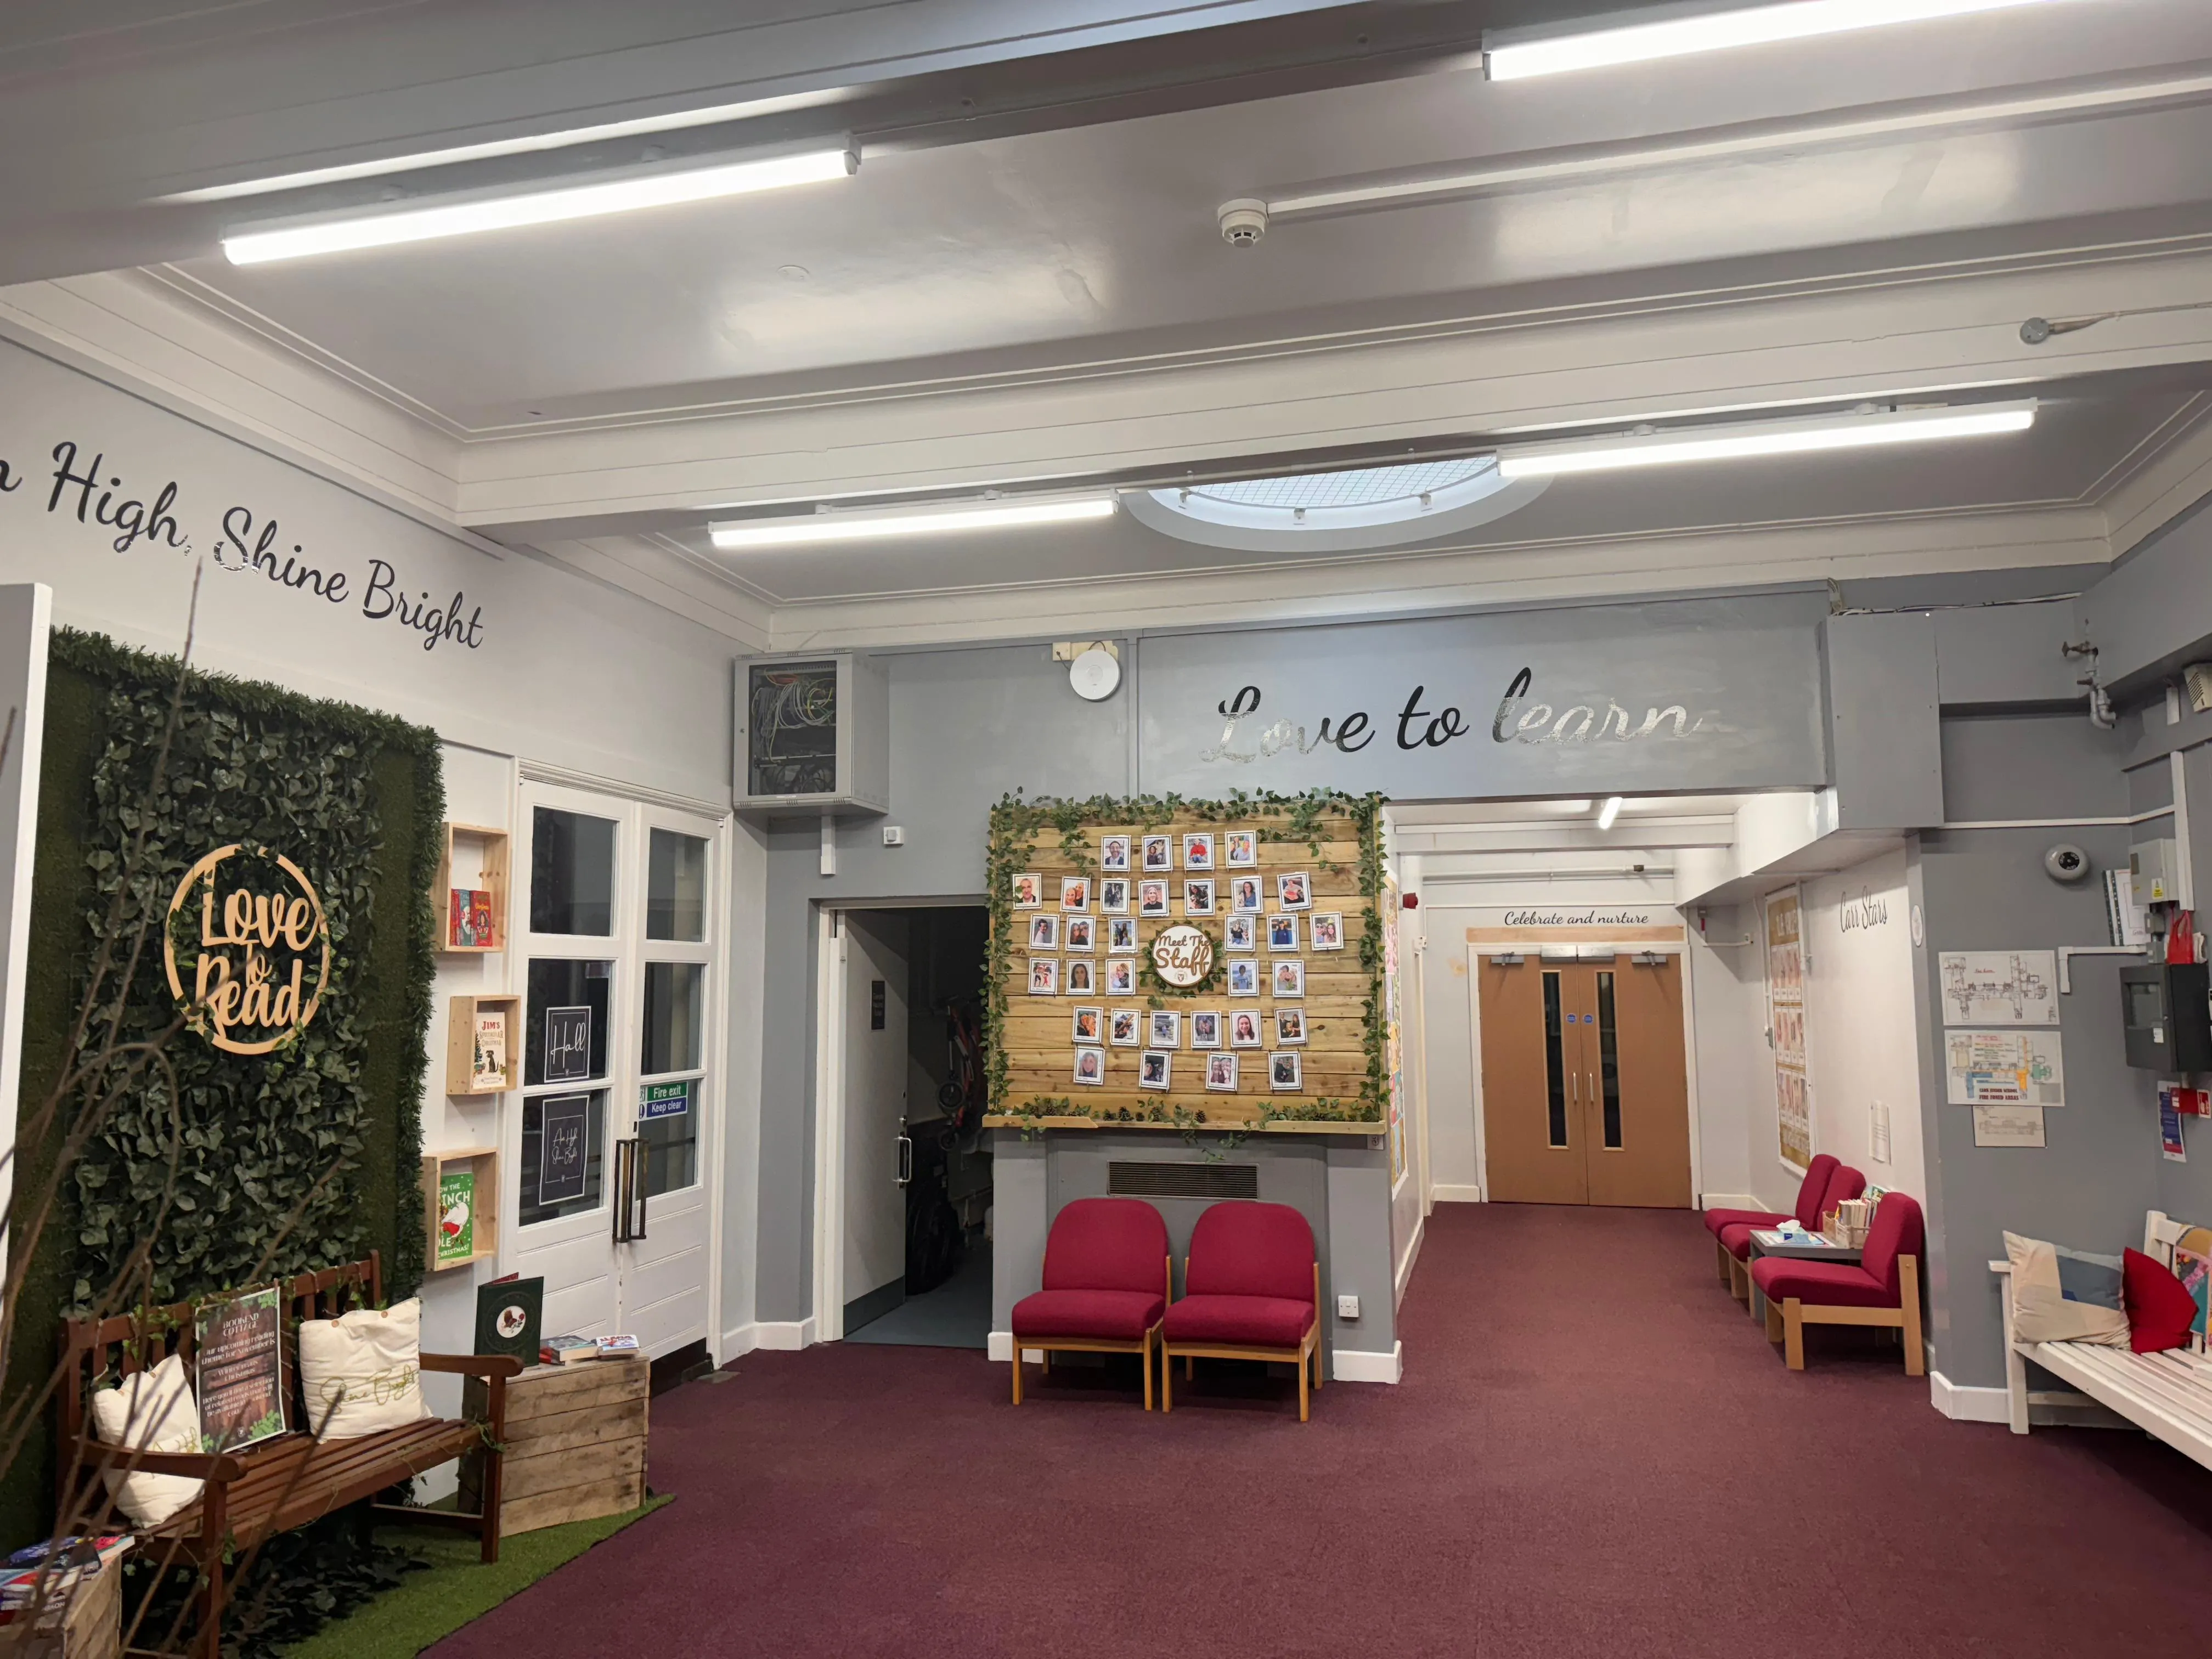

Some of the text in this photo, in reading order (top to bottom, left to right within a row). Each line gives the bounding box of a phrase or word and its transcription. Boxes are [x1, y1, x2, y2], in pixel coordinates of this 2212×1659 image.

[48, 441, 484, 651] High, Shine Bright
[1198, 667, 1703, 764] Love to learn
[201, 861, 320, 951] Love
[1840, 890, 1860, 933] Carr
[1862, 885, 1888, 929] Stars
[1504, 910, 1650, 926] Celebrate and nurture
[1158, 934, 1209, 946] Meet The
[1154, 947, 1210, 977] Staff
[194, 952, 310, 1039] Read
[482, 1021, 500, 1031] JIM'S
[550, 1021, 586, 1069] Hall
[653, 1085, 681, 1098] Fire exit
[651, 1101, 682, 1114] Keep clear
[449, 1182, 460, 1191] THE
[223, 1312, 259, 1329] BOOKEND
[217, 1339, 250, 1352] upcoming
[251, 1331, 275, 1344] reading
[201, 1353, 224, 1365] theme
[225, 1350, 236, 1358] for
[237, 1341, 268, 1354] November
[224, 1368, 255, 1382] Christmas
